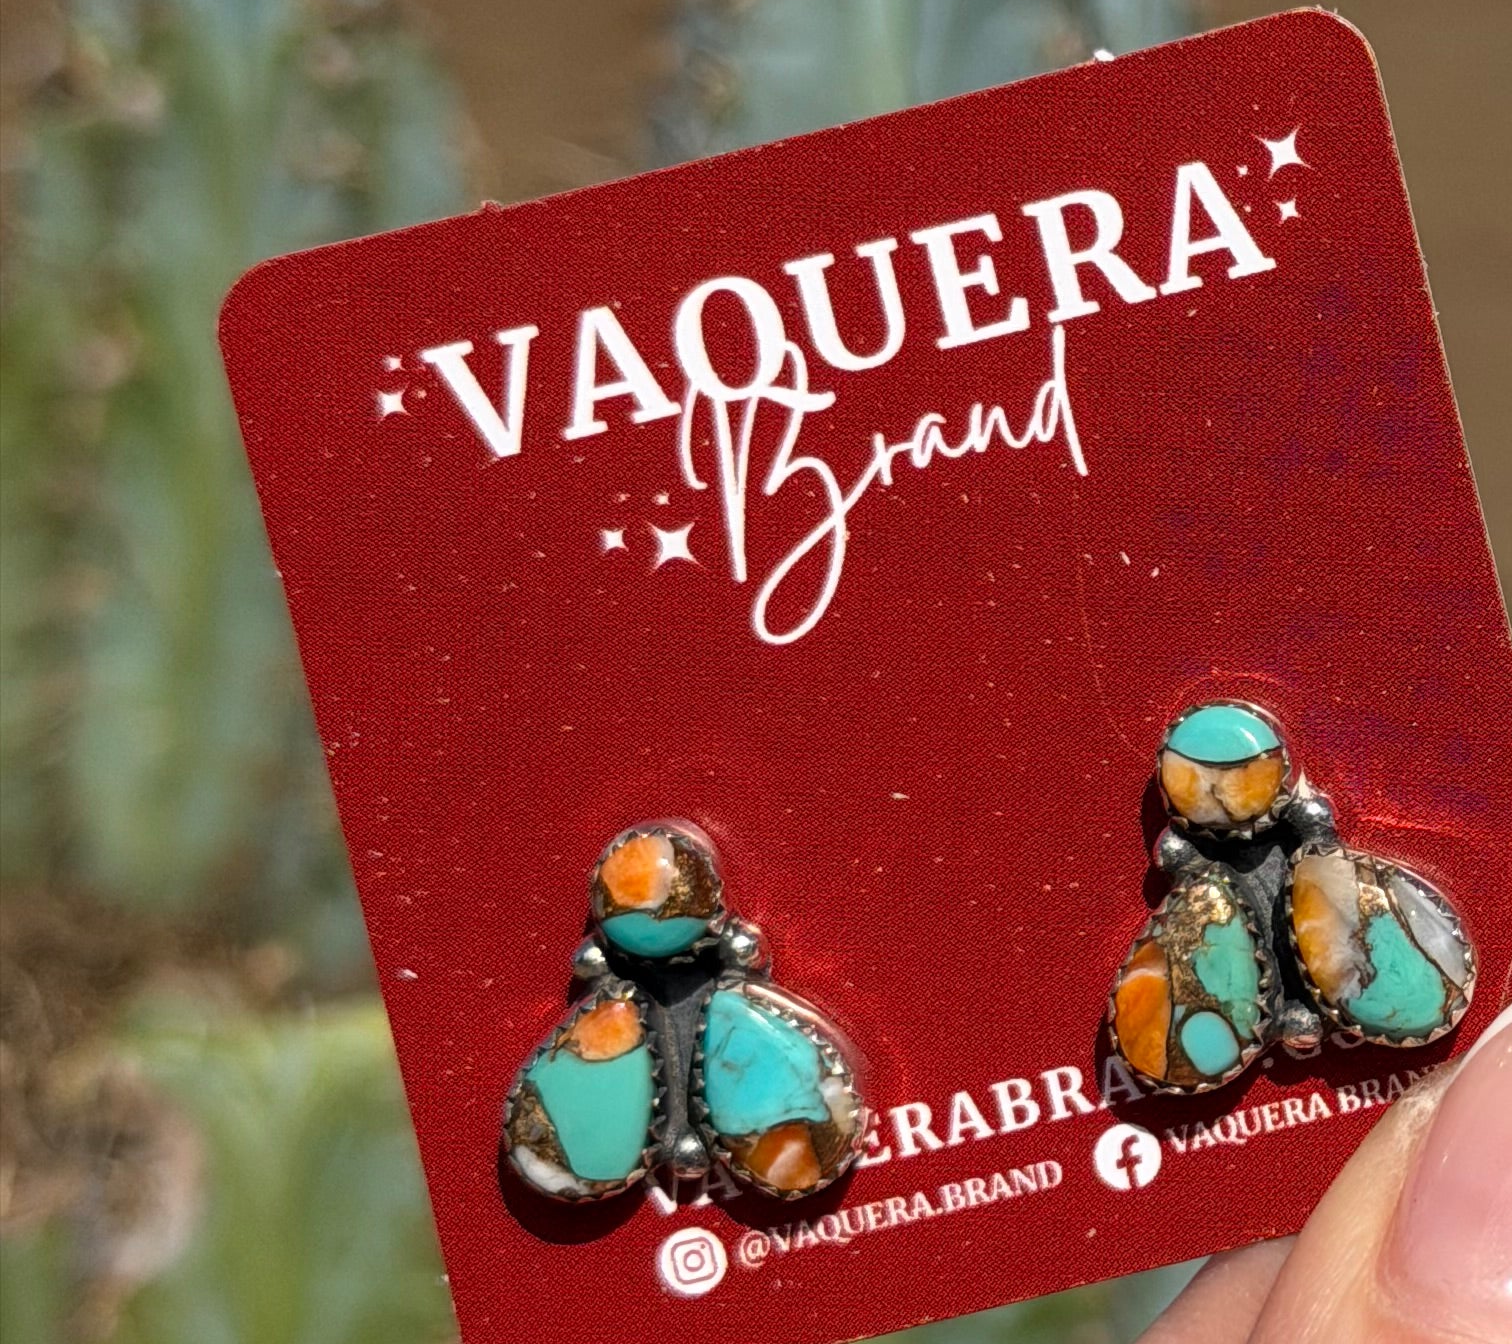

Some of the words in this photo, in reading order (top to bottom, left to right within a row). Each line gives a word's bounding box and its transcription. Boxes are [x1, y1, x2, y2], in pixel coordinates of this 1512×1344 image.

[422, 160, 1277, 458] VAQUERA
[680, 324, 1089, 645] Brand
[1166, 1090, 1331, 1155] VAQUERA
[1336, 1062, 1440, 1114] BRA
[738, 1159, 1064, 1268] @VAQUERA.BRAND
